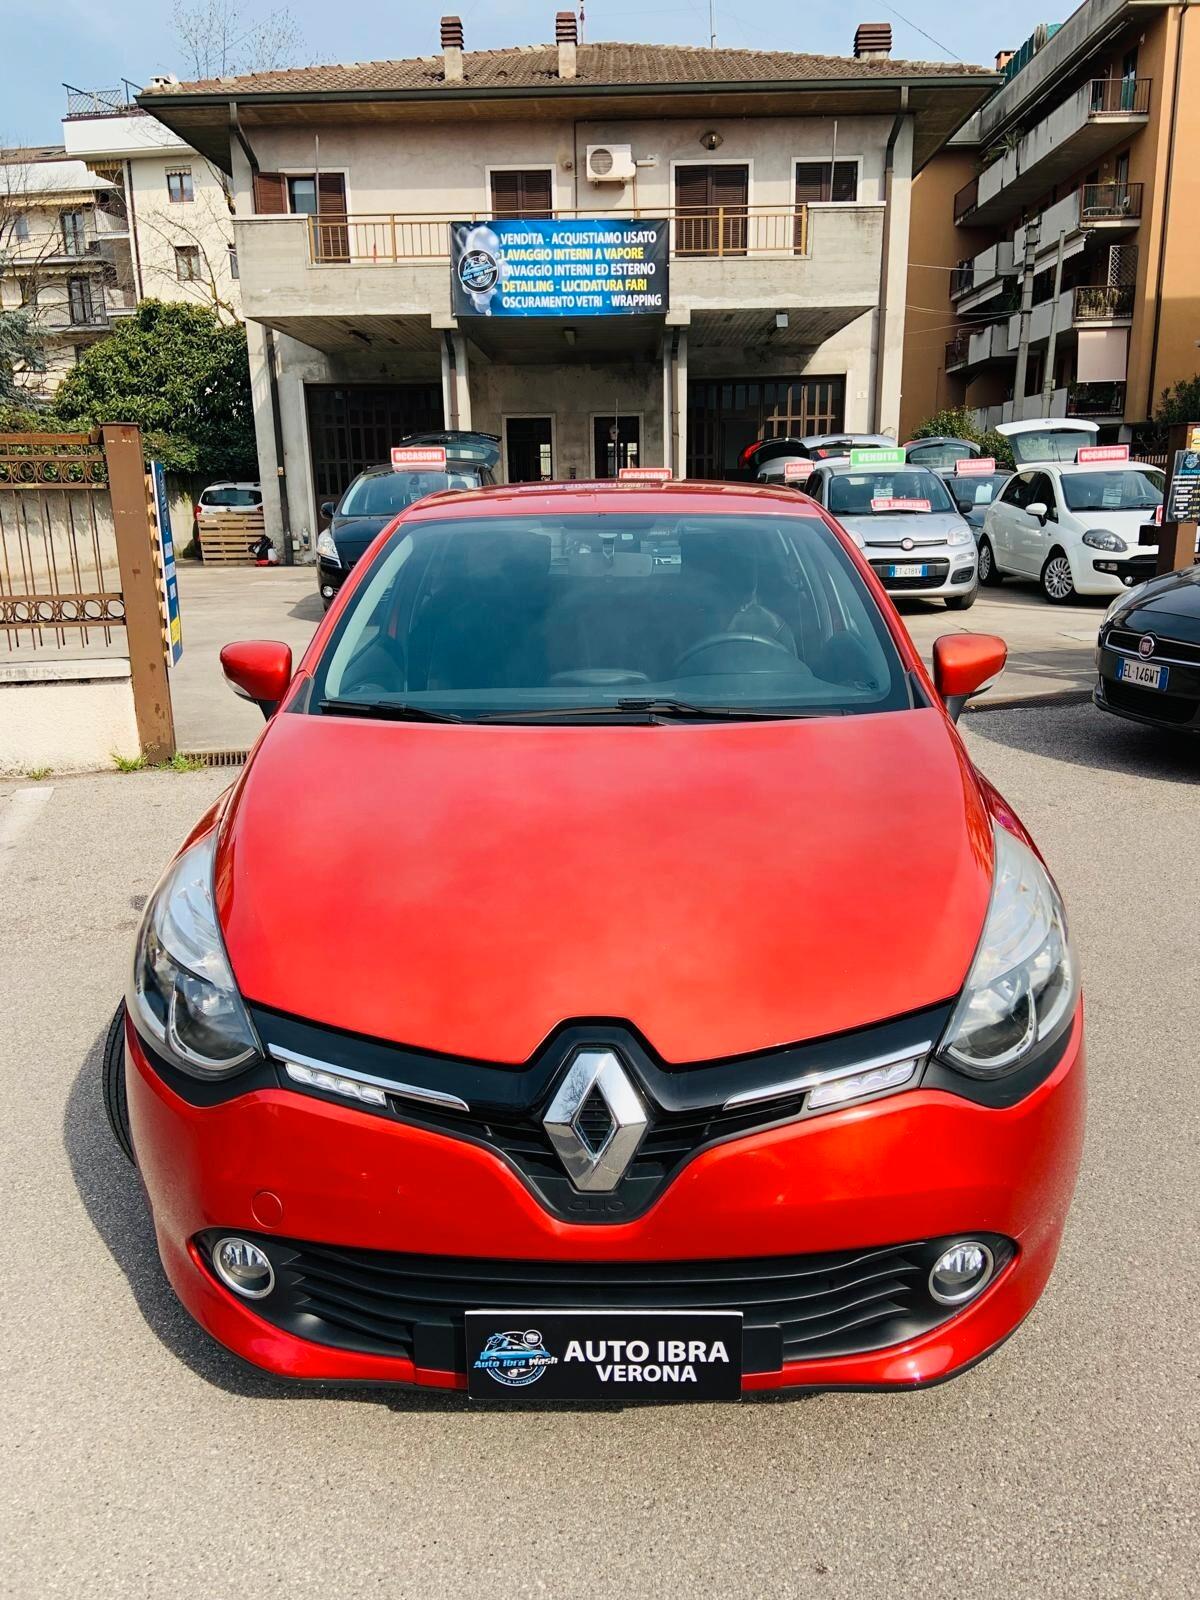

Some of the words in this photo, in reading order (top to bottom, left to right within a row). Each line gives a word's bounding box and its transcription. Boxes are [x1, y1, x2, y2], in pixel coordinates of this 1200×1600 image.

[501, 233, 544, 245] VENDITA
[551, 232, 622, 246] ACQUISTIAMO
[623, 231, 657, 243] USATO
[501, 249, 552, 261] LAVAGGIO
[554, 248, 593, 260] INTERNI
[595, 248, 603, 259] A
[604, 247, 644, 259] VAPORE
[501, 265, 552, 277] LAVAGGIO
[554, 264, 593, 276] INTERNI
[595, 263, 609, 275] ED
[610, 263, 656, 276] ESTERNO
[502, 280, 554, 293] DETAILING
[561, 279, 623, 292] LUCIDATURA
[625, 279, 647, 290] FARI
[502, 296, 575, 308] OSCURAMENTO
[576, 295, 602, 307] VETRI
[611, 294, 662, 307] WRAPPING
[395, 451, 443, 462] OCCASIONE
[858, 452, 898, 462] VENDITA
[567, 1200, 625, 1212] CLIO
[563, 1340, 649, 1363] AUTO
[658, 1341, 729, 1363] IBRA
[473, 1360, 500, 1368] Auto
[528, 1356, 558, 1366] Wash
[595, 1365, 697, 1382] VERONA
